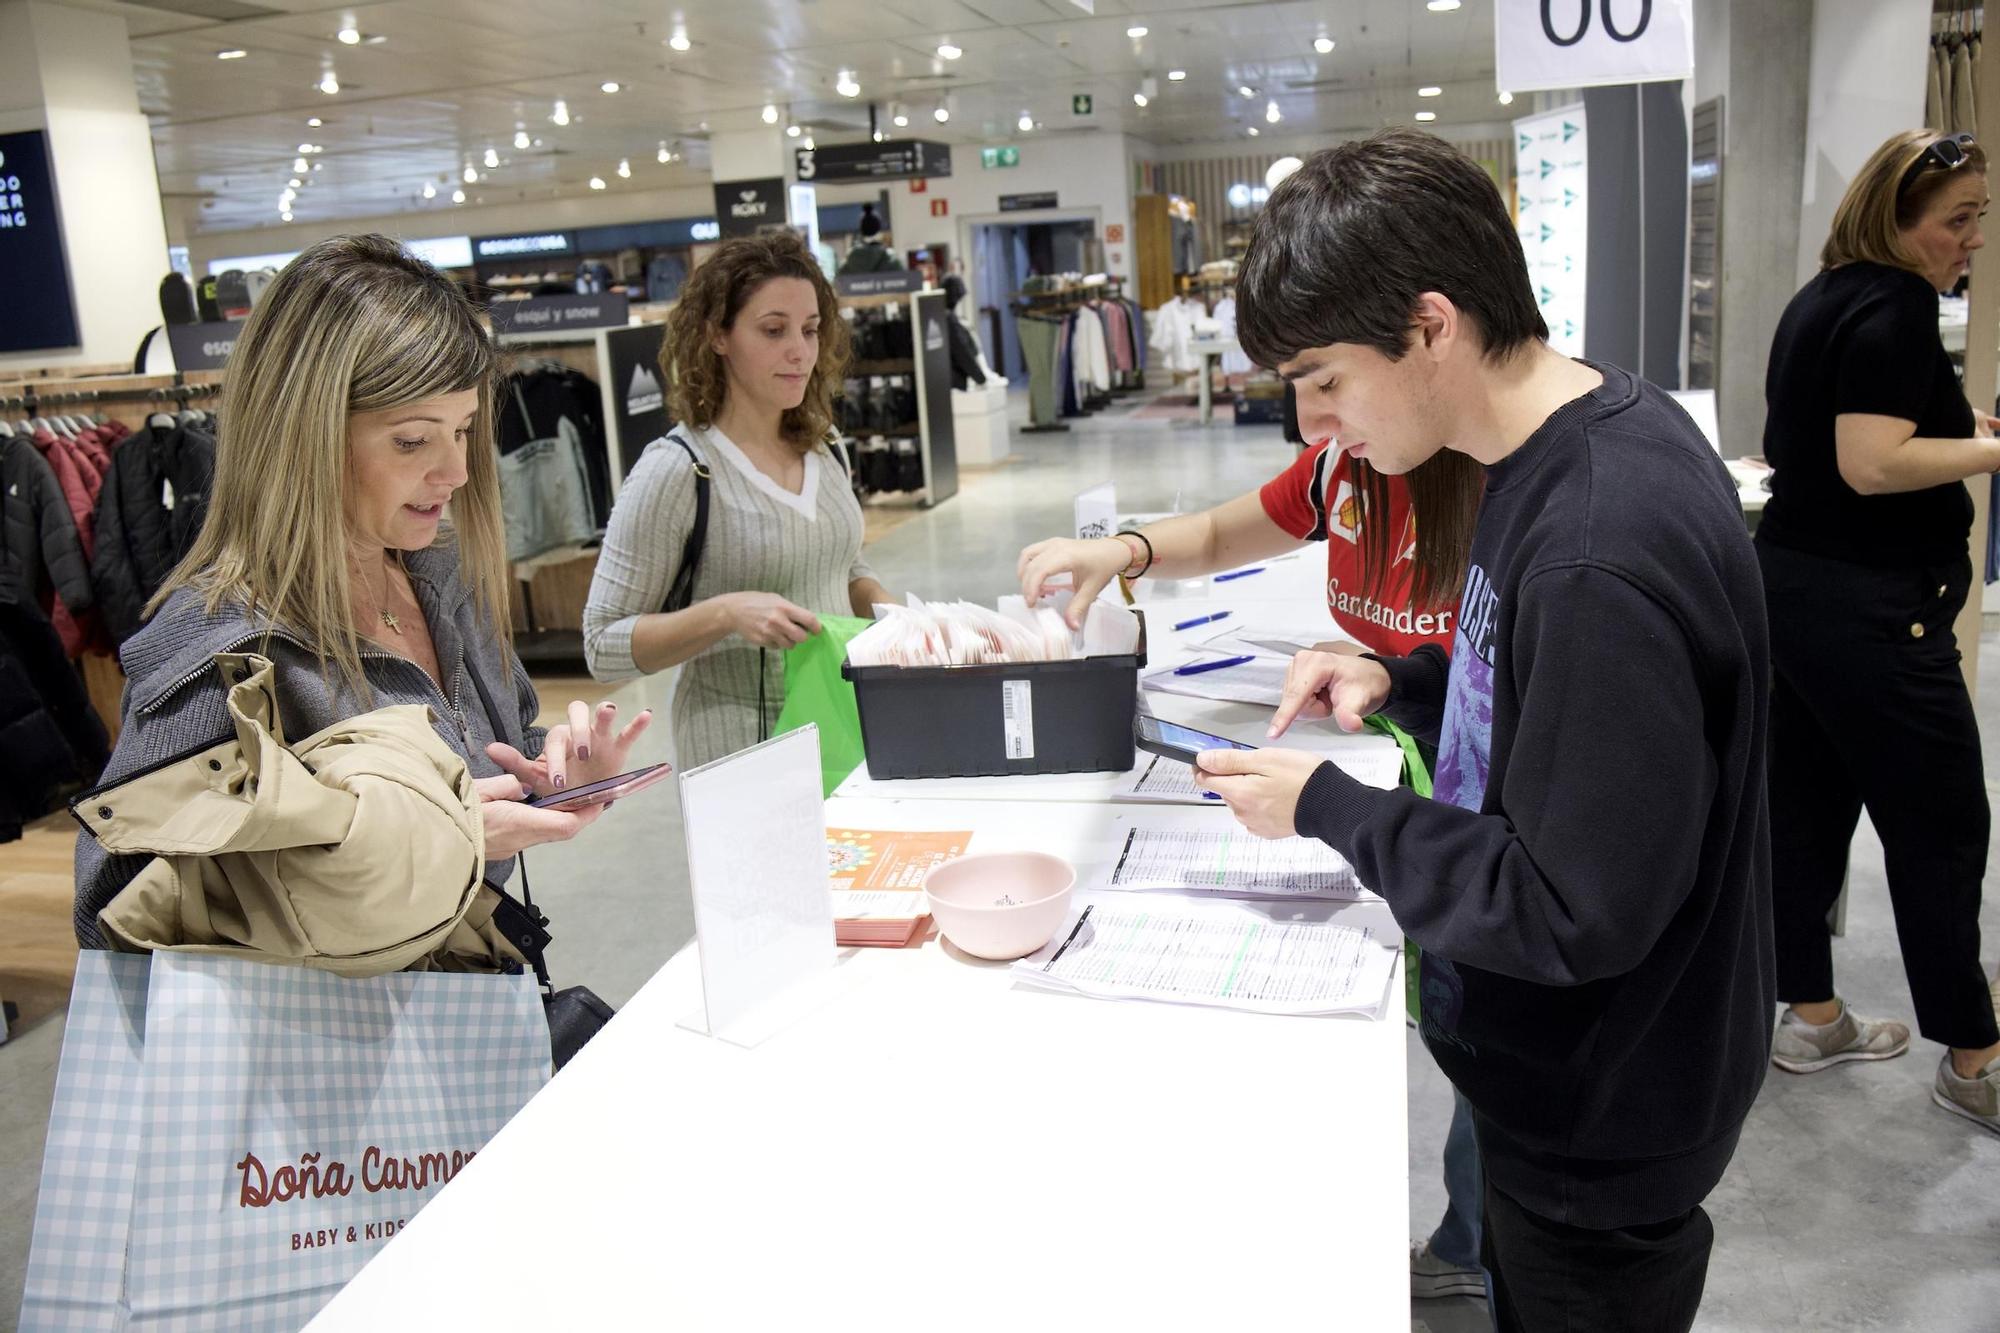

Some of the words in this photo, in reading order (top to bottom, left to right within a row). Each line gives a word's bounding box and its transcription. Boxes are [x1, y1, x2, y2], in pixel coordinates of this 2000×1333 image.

[798, 151, 816, 178] 3
[1328, 578, 1452, 636] Santander
[237, 1151, 354, 1208] Doña
[291, 1228, 339, 1251] BABY
[346, 1226, 358, 1243] &
